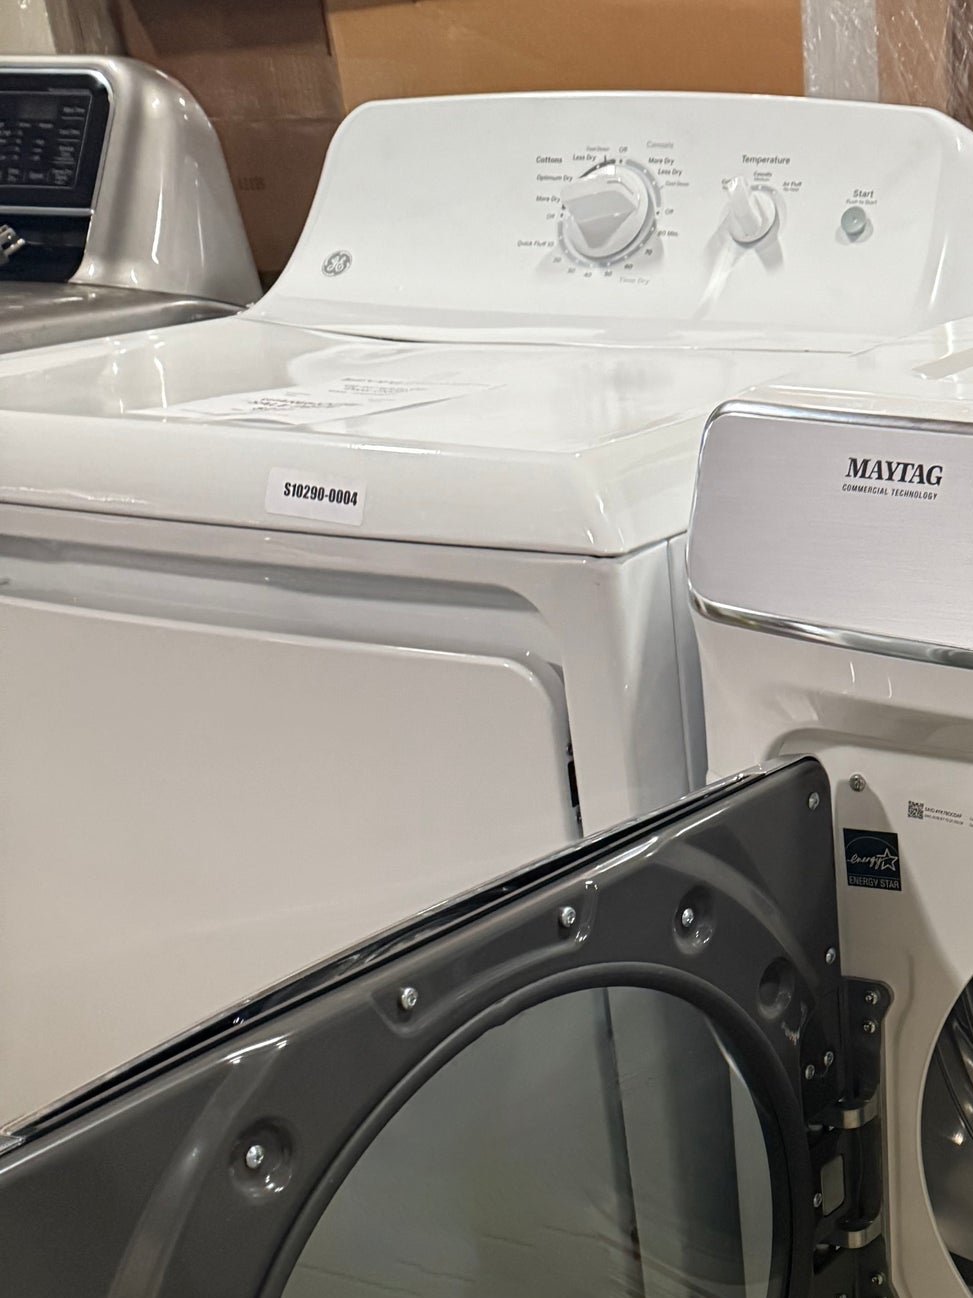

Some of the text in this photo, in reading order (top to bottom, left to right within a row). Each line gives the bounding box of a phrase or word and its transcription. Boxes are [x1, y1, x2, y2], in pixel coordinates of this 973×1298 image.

[535, 156, 562, 164] Cottons
[663, 157, 675, 166] Dry
[742, 154, 790, 166] Temperature
[672, 168, 682, 176] Dry
[853, 189, 874, 198] Start
[845, 457, 943, 487] MAYTAG
[283, 481, 358, 507] S10290-0004
[842, 483, 938, 500] COMMERCIAL TECHNOLOGY
[850, 853, 882, 871] energy
[849, 875, 900, 889] ENERGY STAR
